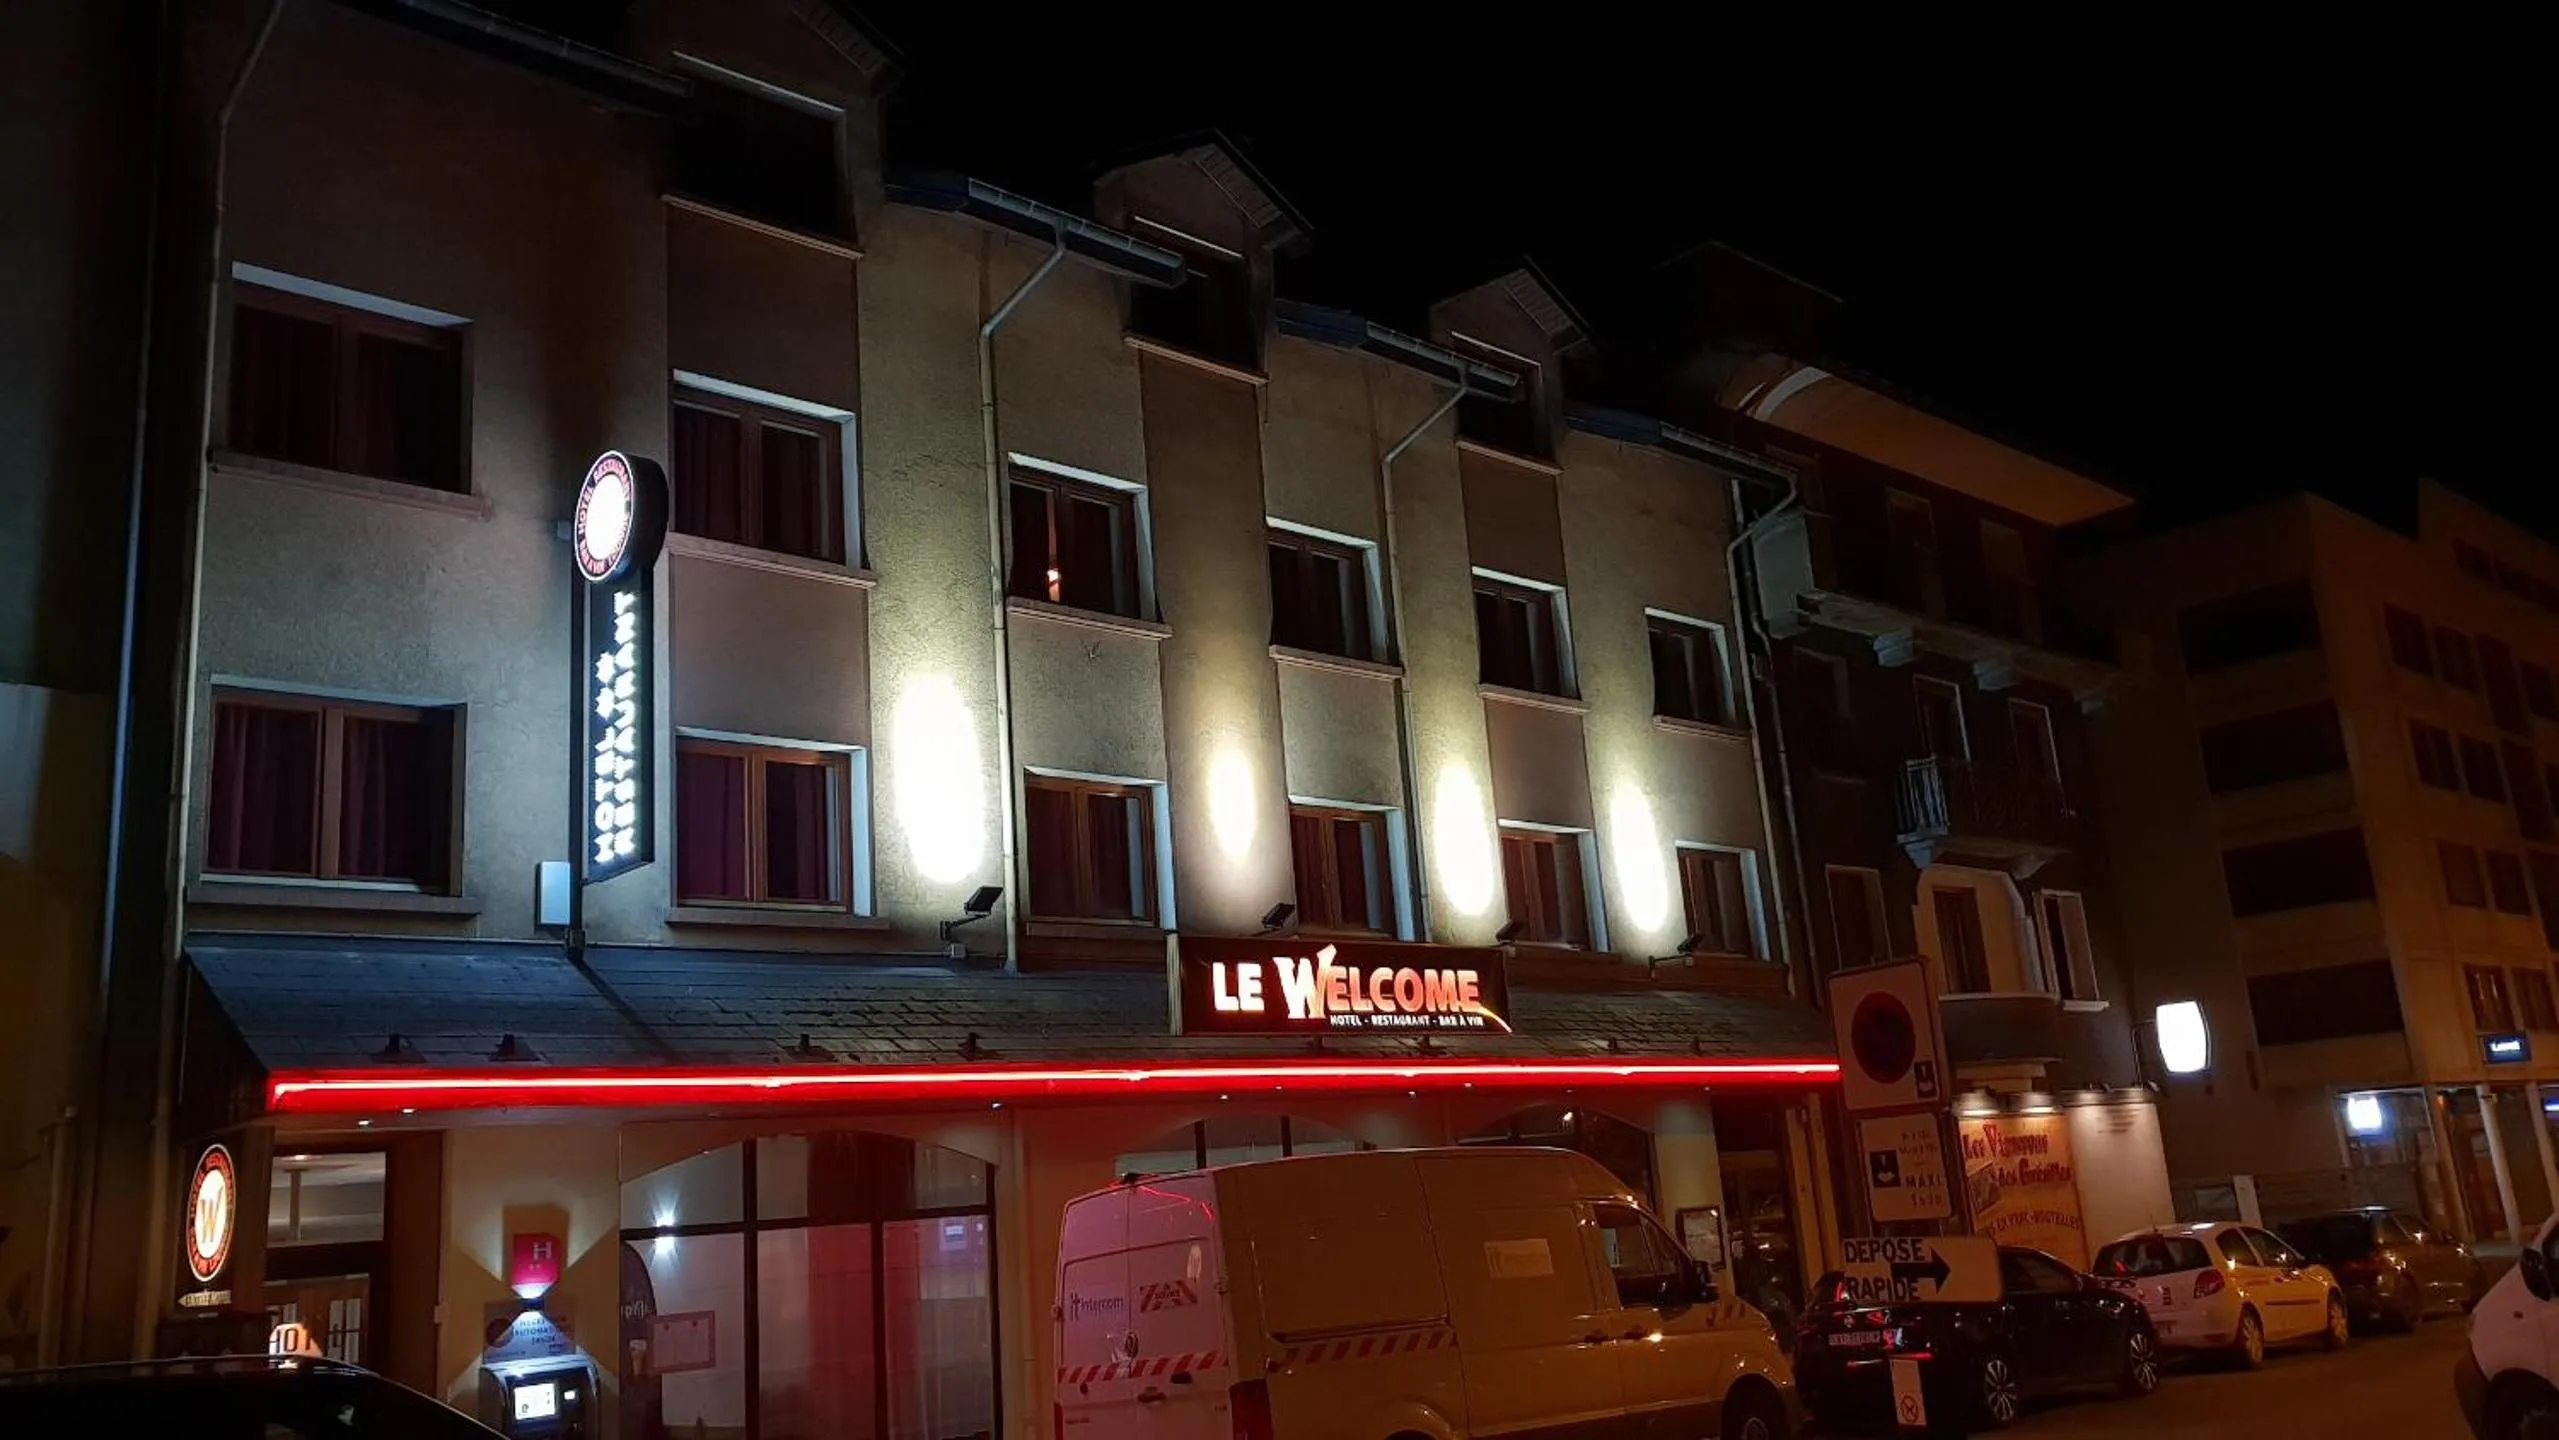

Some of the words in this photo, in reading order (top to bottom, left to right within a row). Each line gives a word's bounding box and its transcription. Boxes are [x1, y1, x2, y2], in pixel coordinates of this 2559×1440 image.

[1212, 962, 1265, 1012] LE
[1330, 1014, 1362, 1026] HOTEL
[1371, 1014, 1430, 1027] RESTAURANT
[532, 1241, 552, 1261] H
[1844, 1238, 1925, 1263] DEPOSE
[1846, 1277, 1921, 1301] RAPIDE
